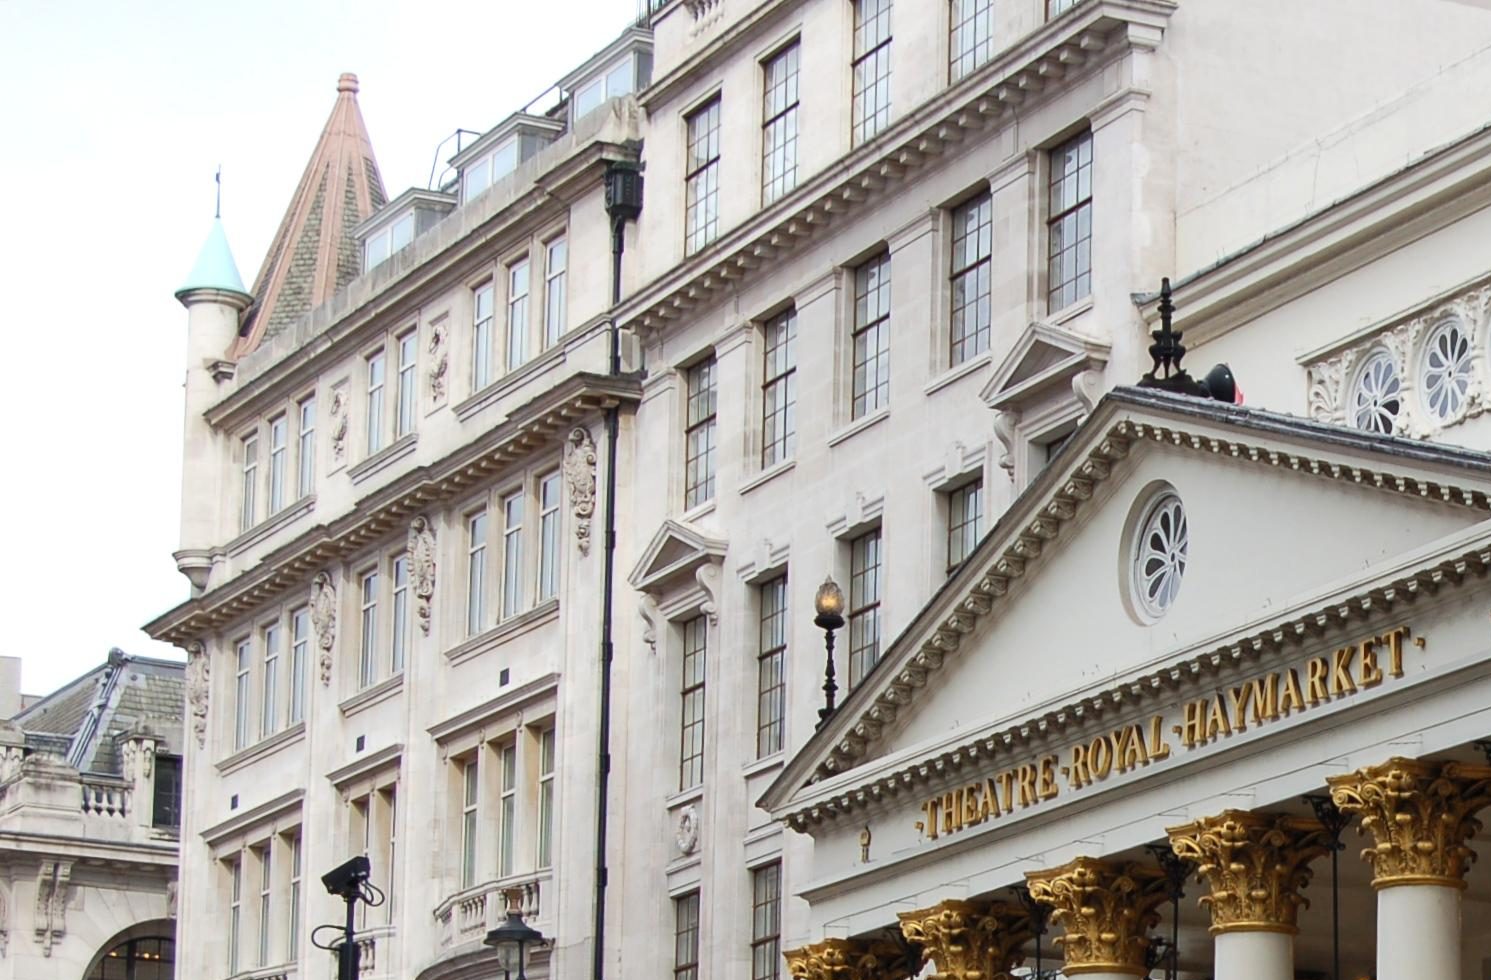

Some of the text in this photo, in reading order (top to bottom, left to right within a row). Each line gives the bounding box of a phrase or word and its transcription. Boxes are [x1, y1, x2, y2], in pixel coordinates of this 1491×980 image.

[920, 625, 1411, 841] THEATRE ROYAL HAYMARKET
